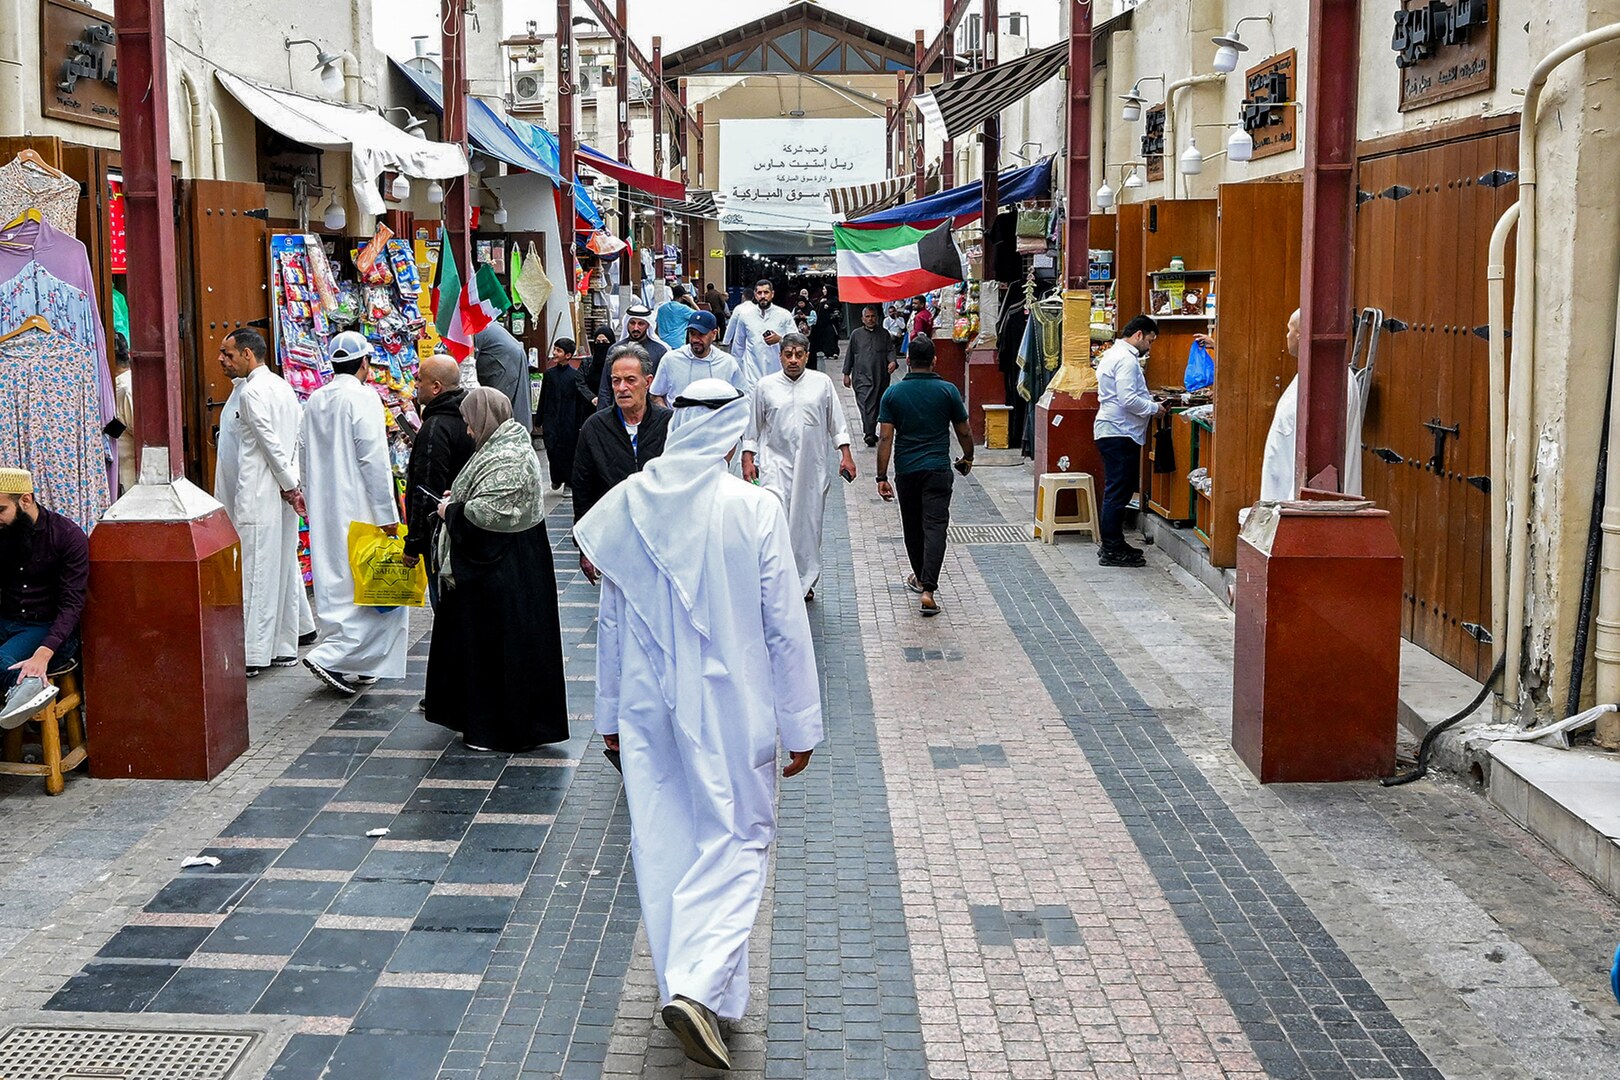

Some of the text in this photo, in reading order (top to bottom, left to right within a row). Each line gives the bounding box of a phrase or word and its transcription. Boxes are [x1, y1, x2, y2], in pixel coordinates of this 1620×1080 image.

[783, 145, 827, 154] ترحب شركة
[754, 159, 785, 171] هاوس
[830, 158, 854, 170] ريل
[732, 187, 783, 202] المباركية
[786, 188, 820, 202] سوق
